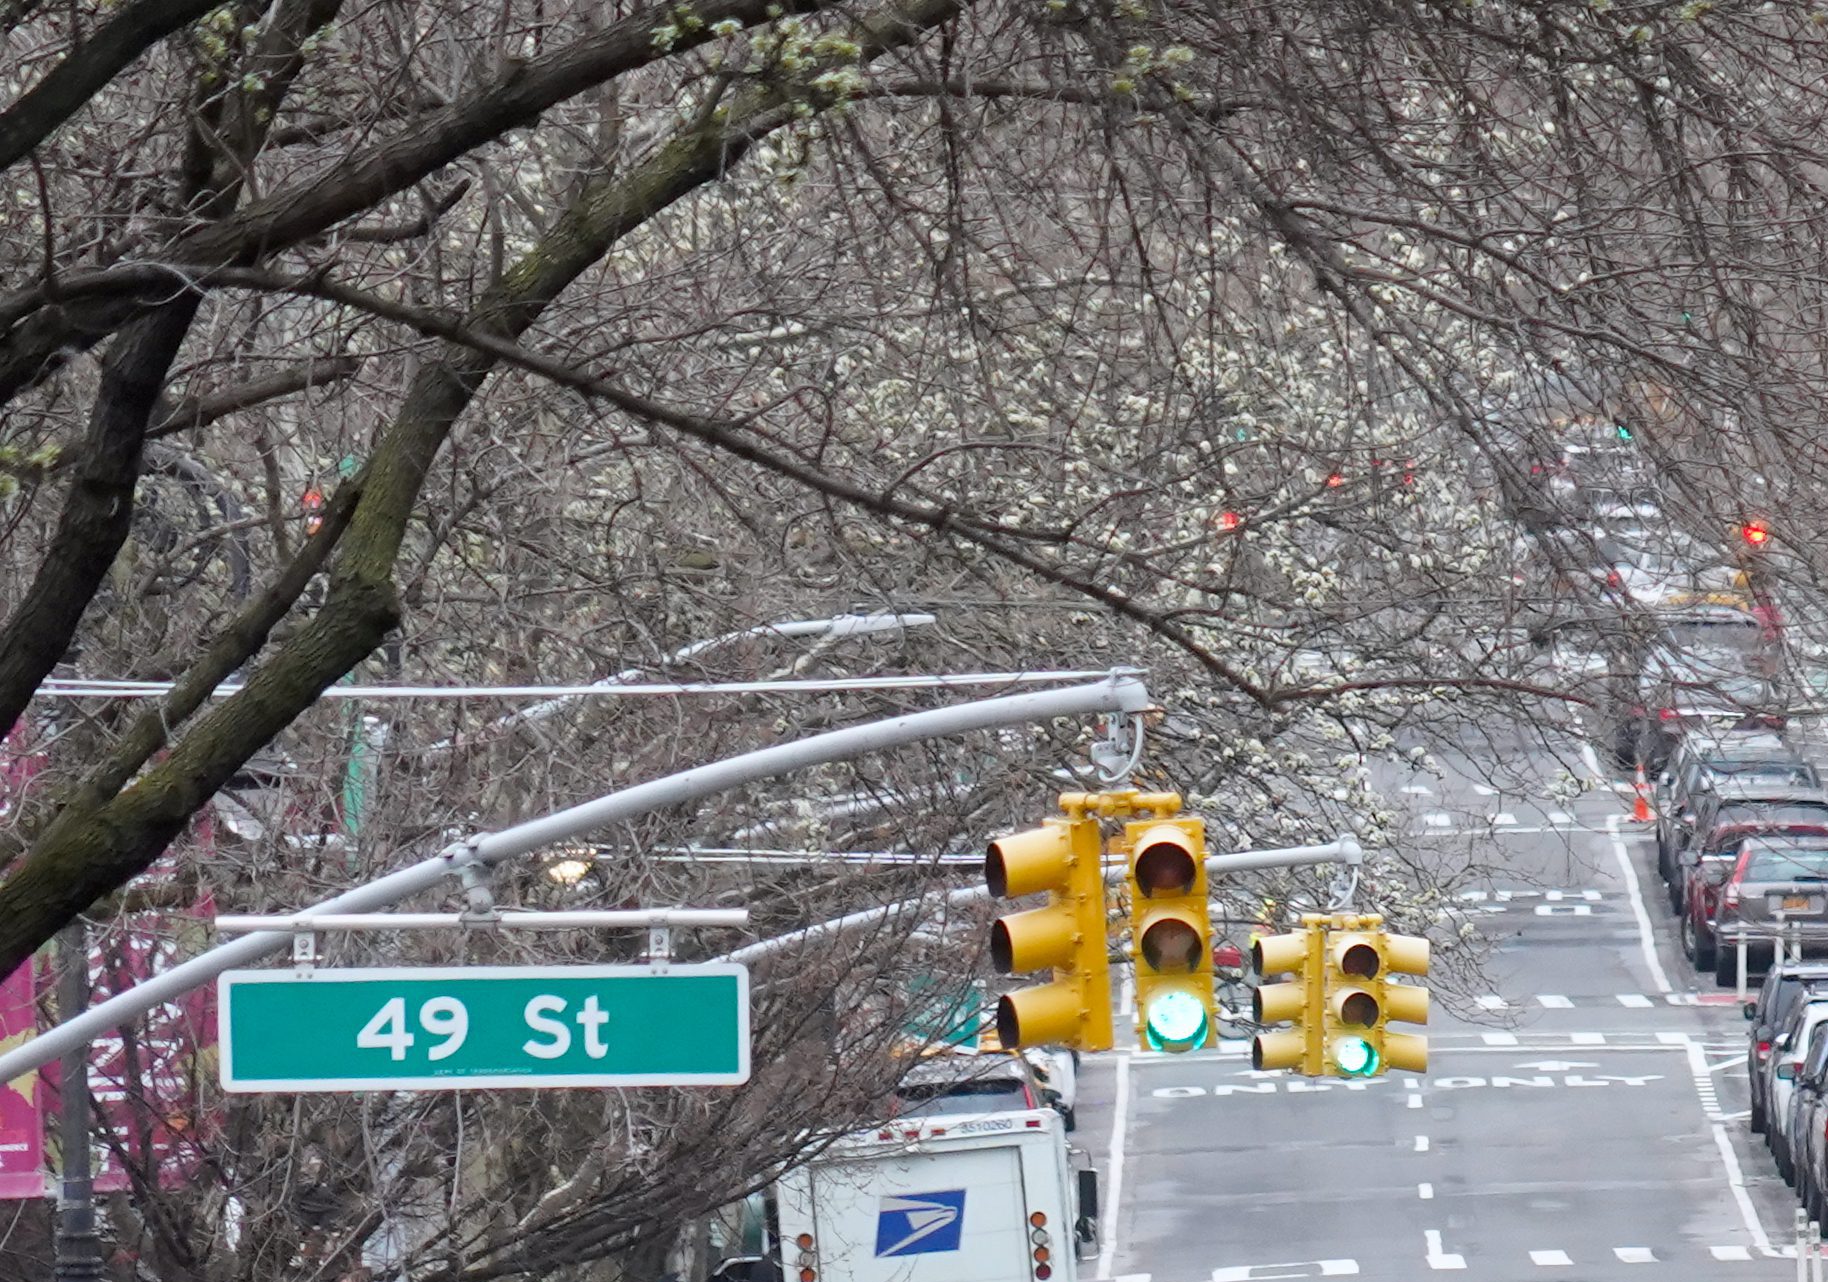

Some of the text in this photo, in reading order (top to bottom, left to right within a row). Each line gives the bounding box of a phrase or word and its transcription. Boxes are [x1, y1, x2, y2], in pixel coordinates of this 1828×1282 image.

[356, 993, 610, 1061] 49 St
[1432, 1073, 1666, 1089] ONLY
